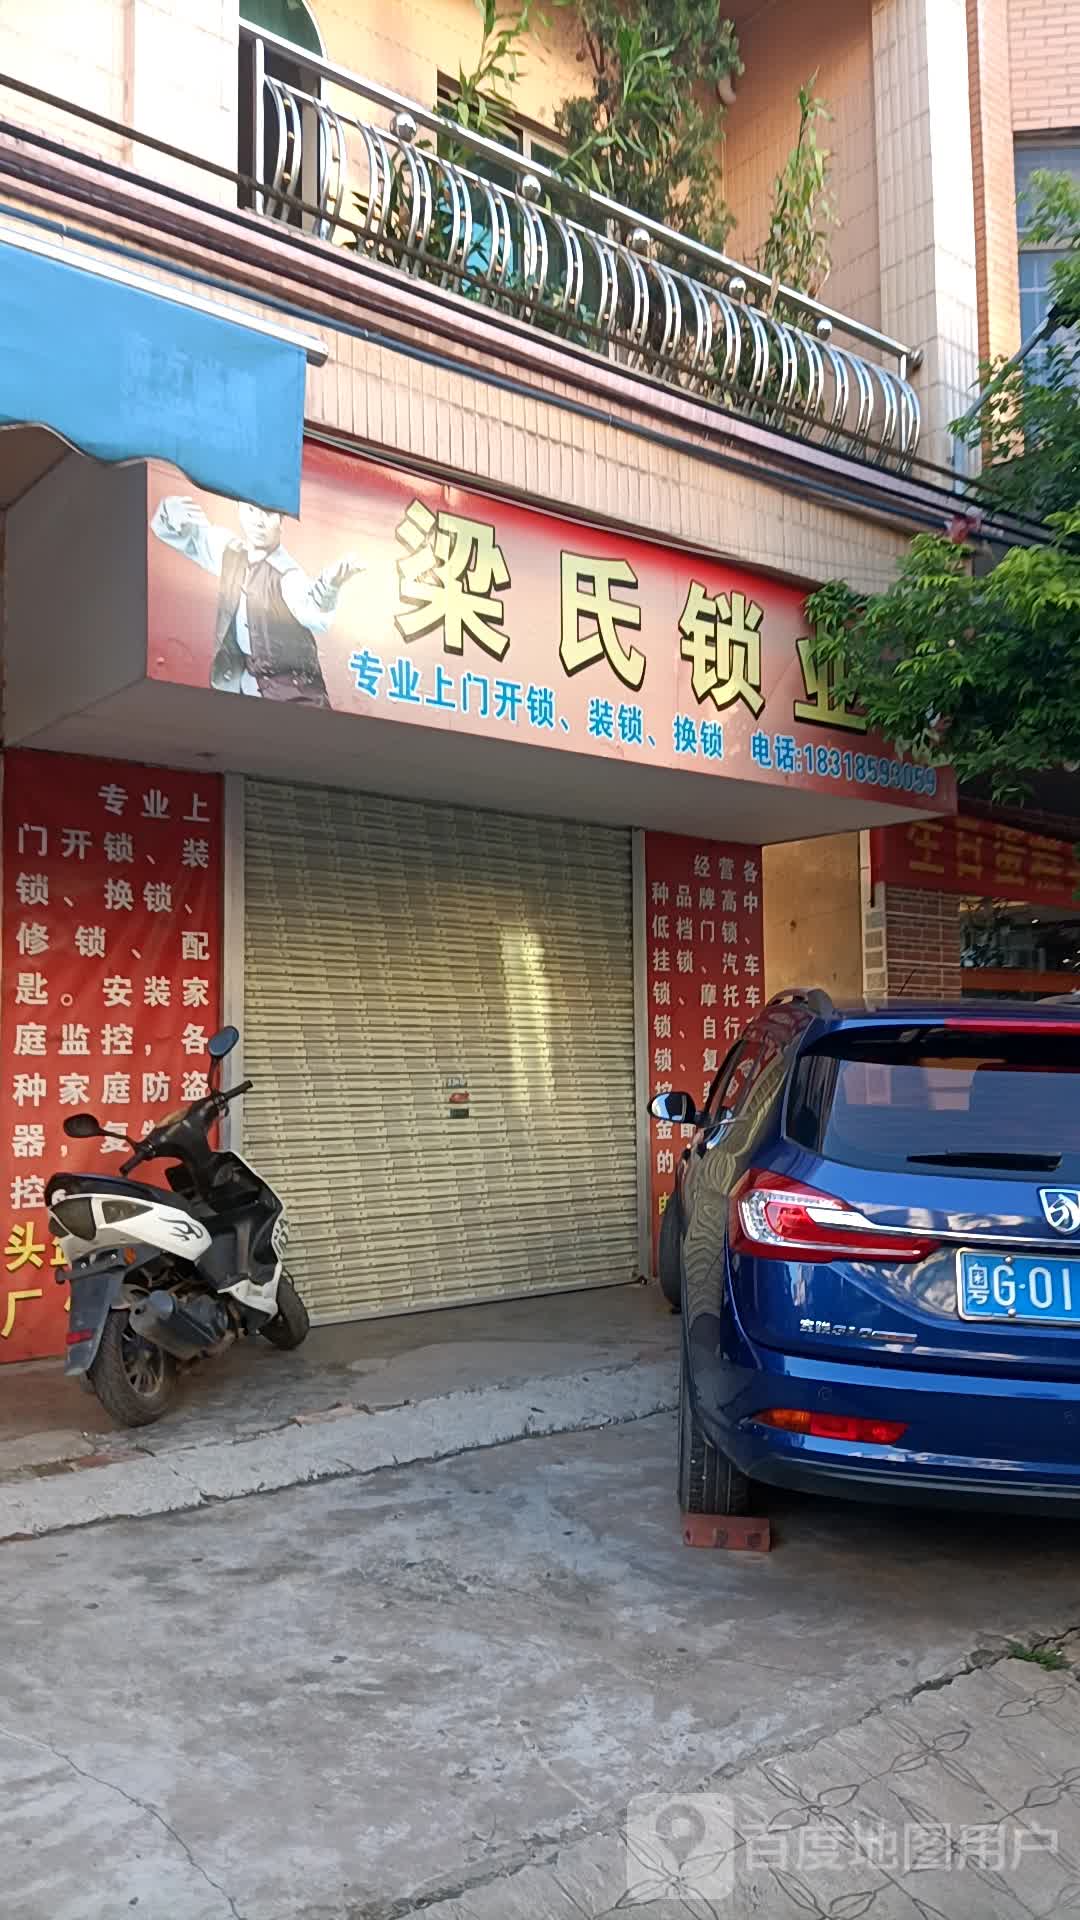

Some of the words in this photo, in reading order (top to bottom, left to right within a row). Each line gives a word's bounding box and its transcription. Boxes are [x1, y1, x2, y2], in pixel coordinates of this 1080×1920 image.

[394, 498, 868, 735] 梁氏锁业
[348, 649, 724, 760] 专业上门开锁、装锁、换锁
[98, 783, 210, 823] 专业上
[17, 823, 209, 869] 门开锁、装
[693, 855, 760, 884] 经营各
[651, 881, 760, 915] 种品牌高中
[15, 921, 210, 961] 修锁、配
[652, 947, 761, 977] 挂锁、汽车
[15, 972, 210, 1008] 匙。安装家
[653, 980, 762, 1009] 锁、摩托车
[653, 1014, 757, 1041] 锁、自行
[654, 1047, 729, 1073] 锁、复
[12, 1071, 209, 1108] 种家庭防盗
[657, 1148, 674, 1174] 的
